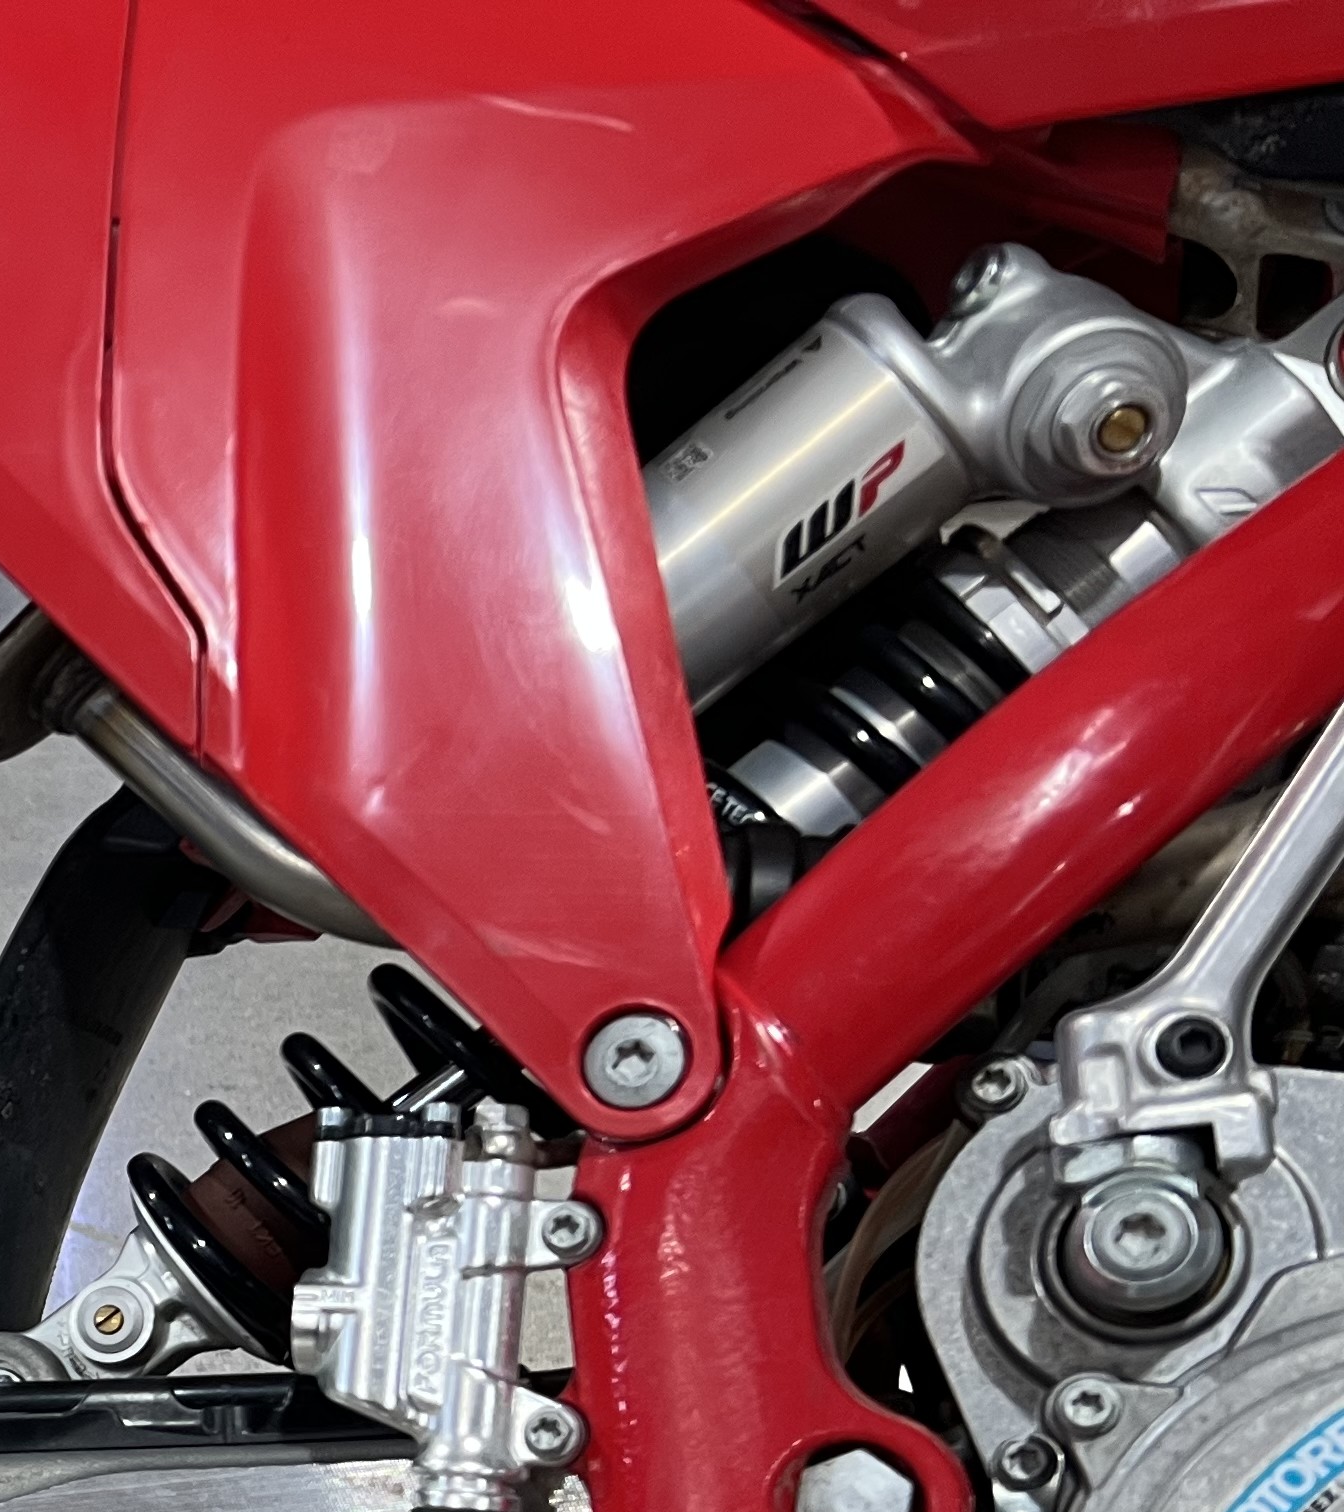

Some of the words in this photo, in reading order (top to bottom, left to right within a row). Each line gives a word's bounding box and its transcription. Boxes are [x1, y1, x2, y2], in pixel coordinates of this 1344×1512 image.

[781, 439, 905, 580] WP
[790, 534, 865, 603] XACT
[414, 1243, 451, 1393] FORMULA
